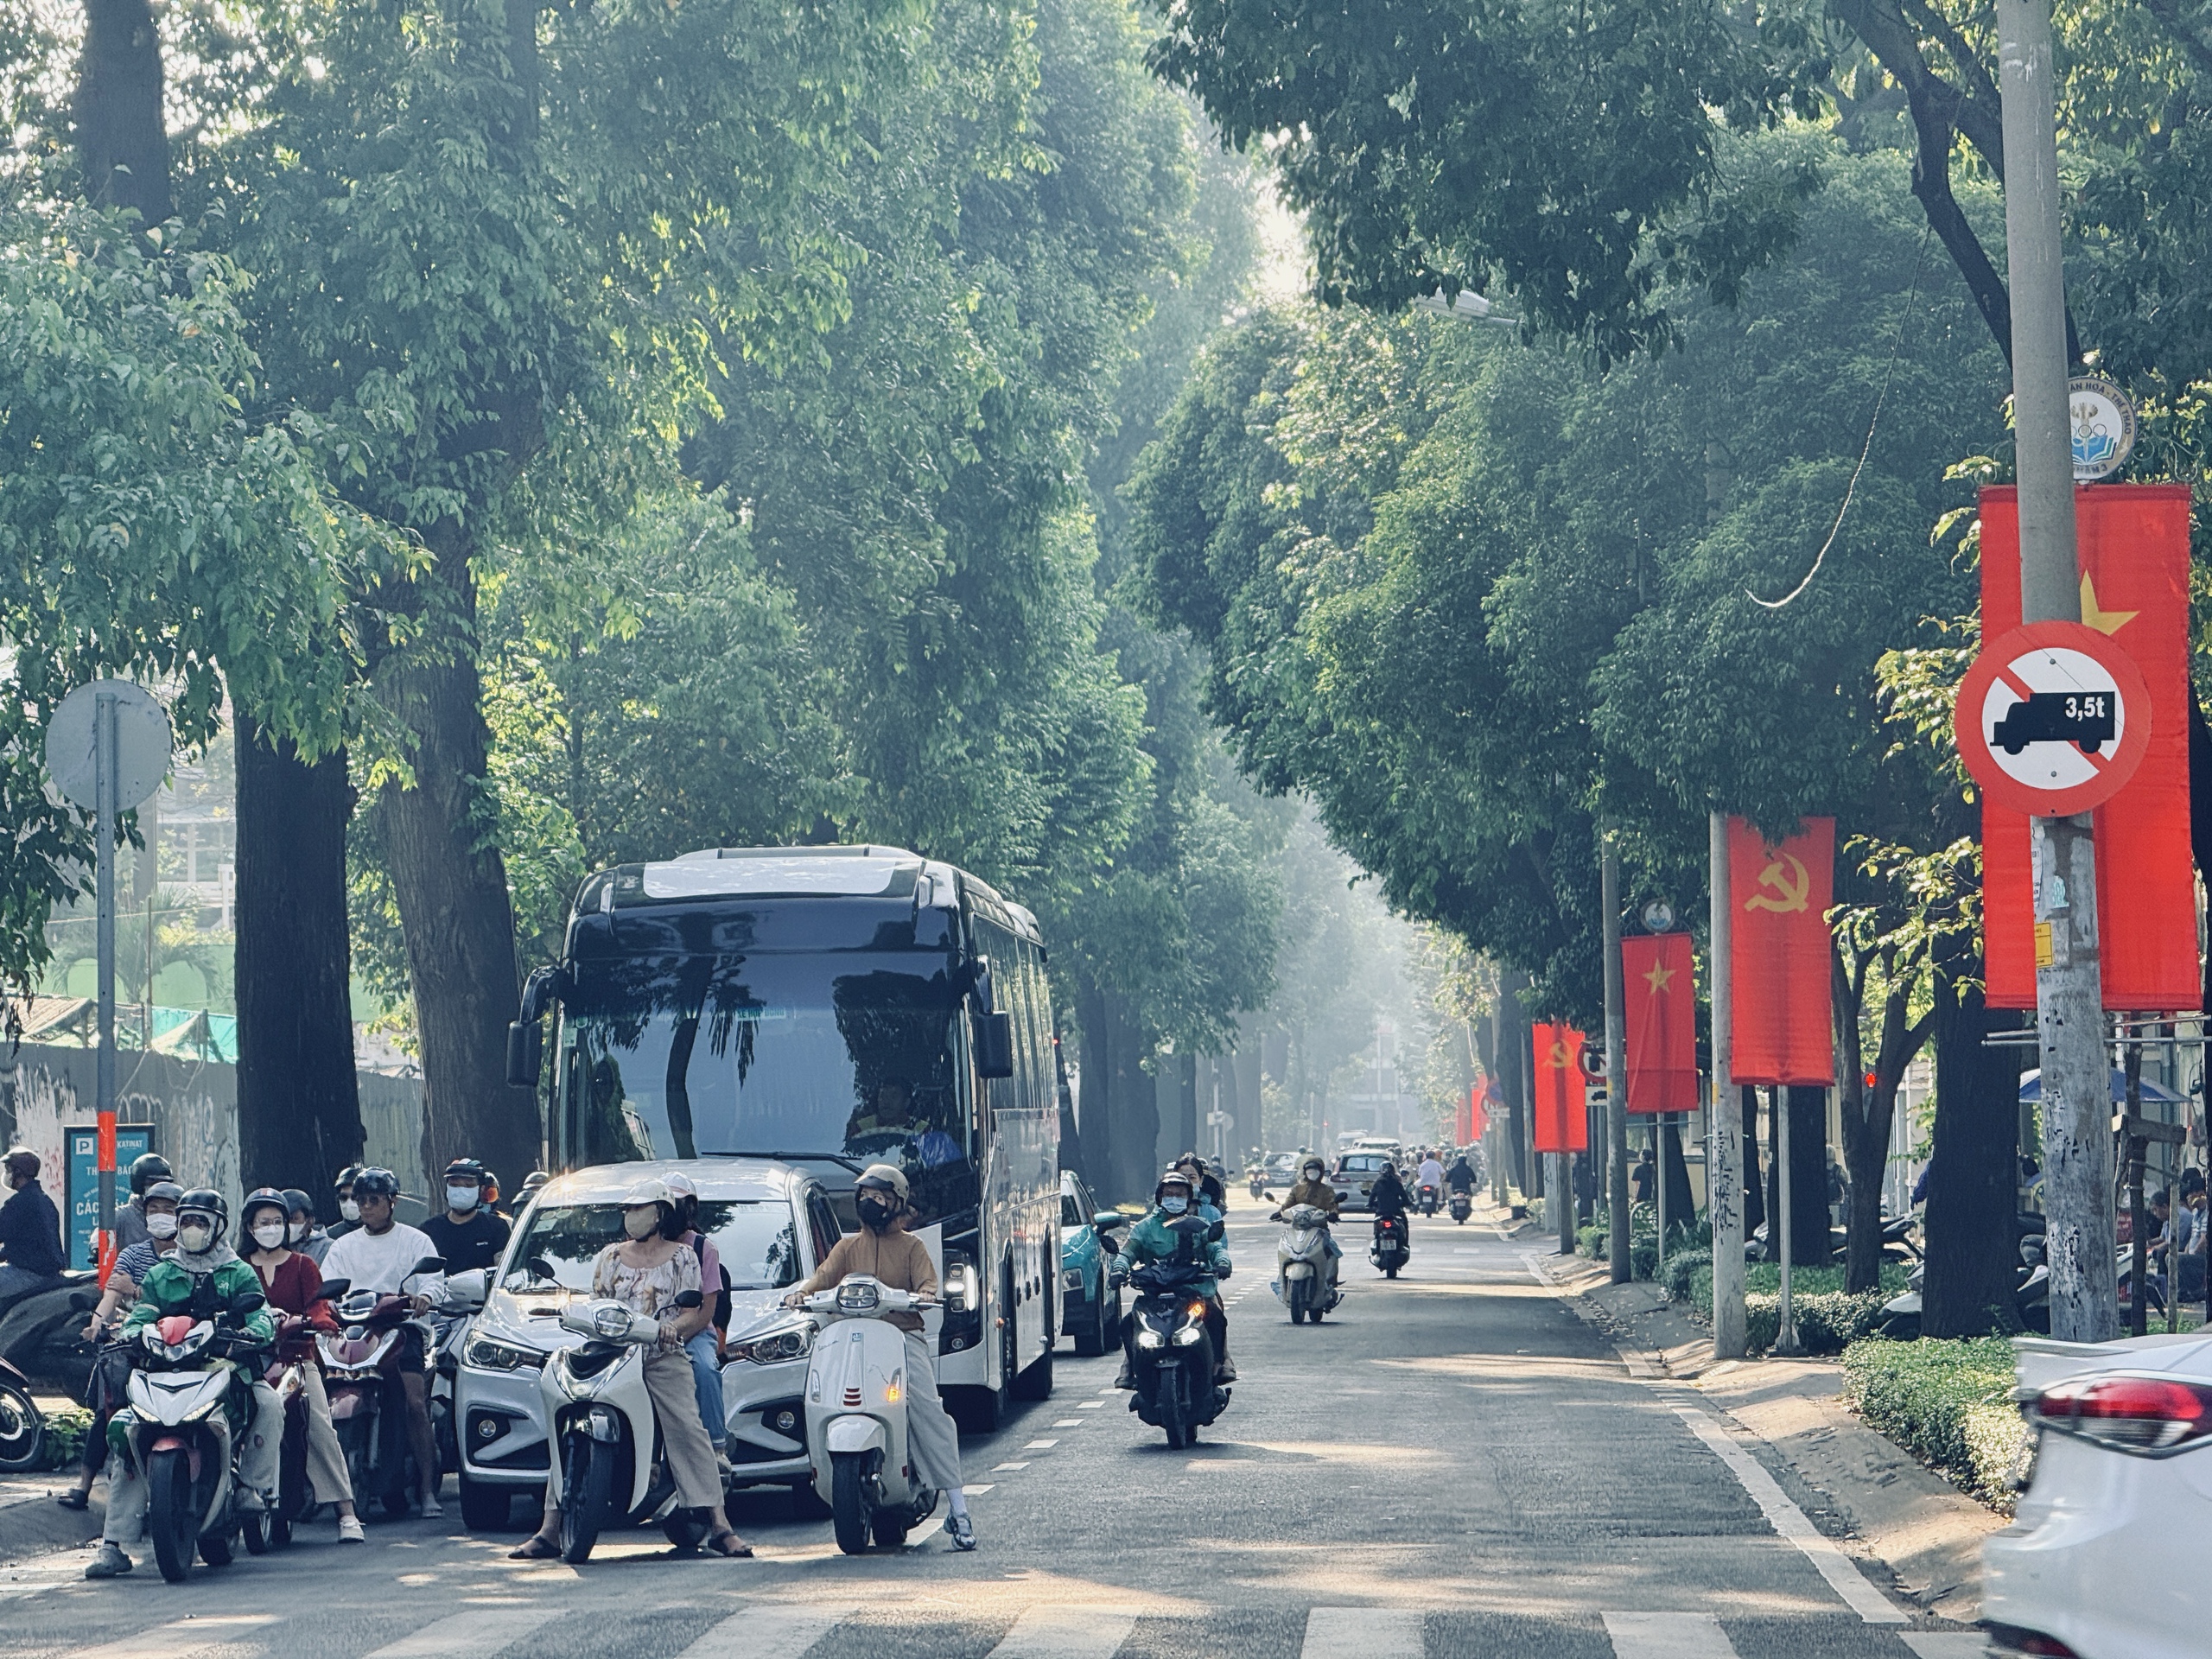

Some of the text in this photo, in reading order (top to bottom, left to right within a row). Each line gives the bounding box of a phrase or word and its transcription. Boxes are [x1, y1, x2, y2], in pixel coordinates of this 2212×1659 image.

[2065, 696, 2105, 721] 3,5t
[79, 1140, 143, 1153] P KATINAT
